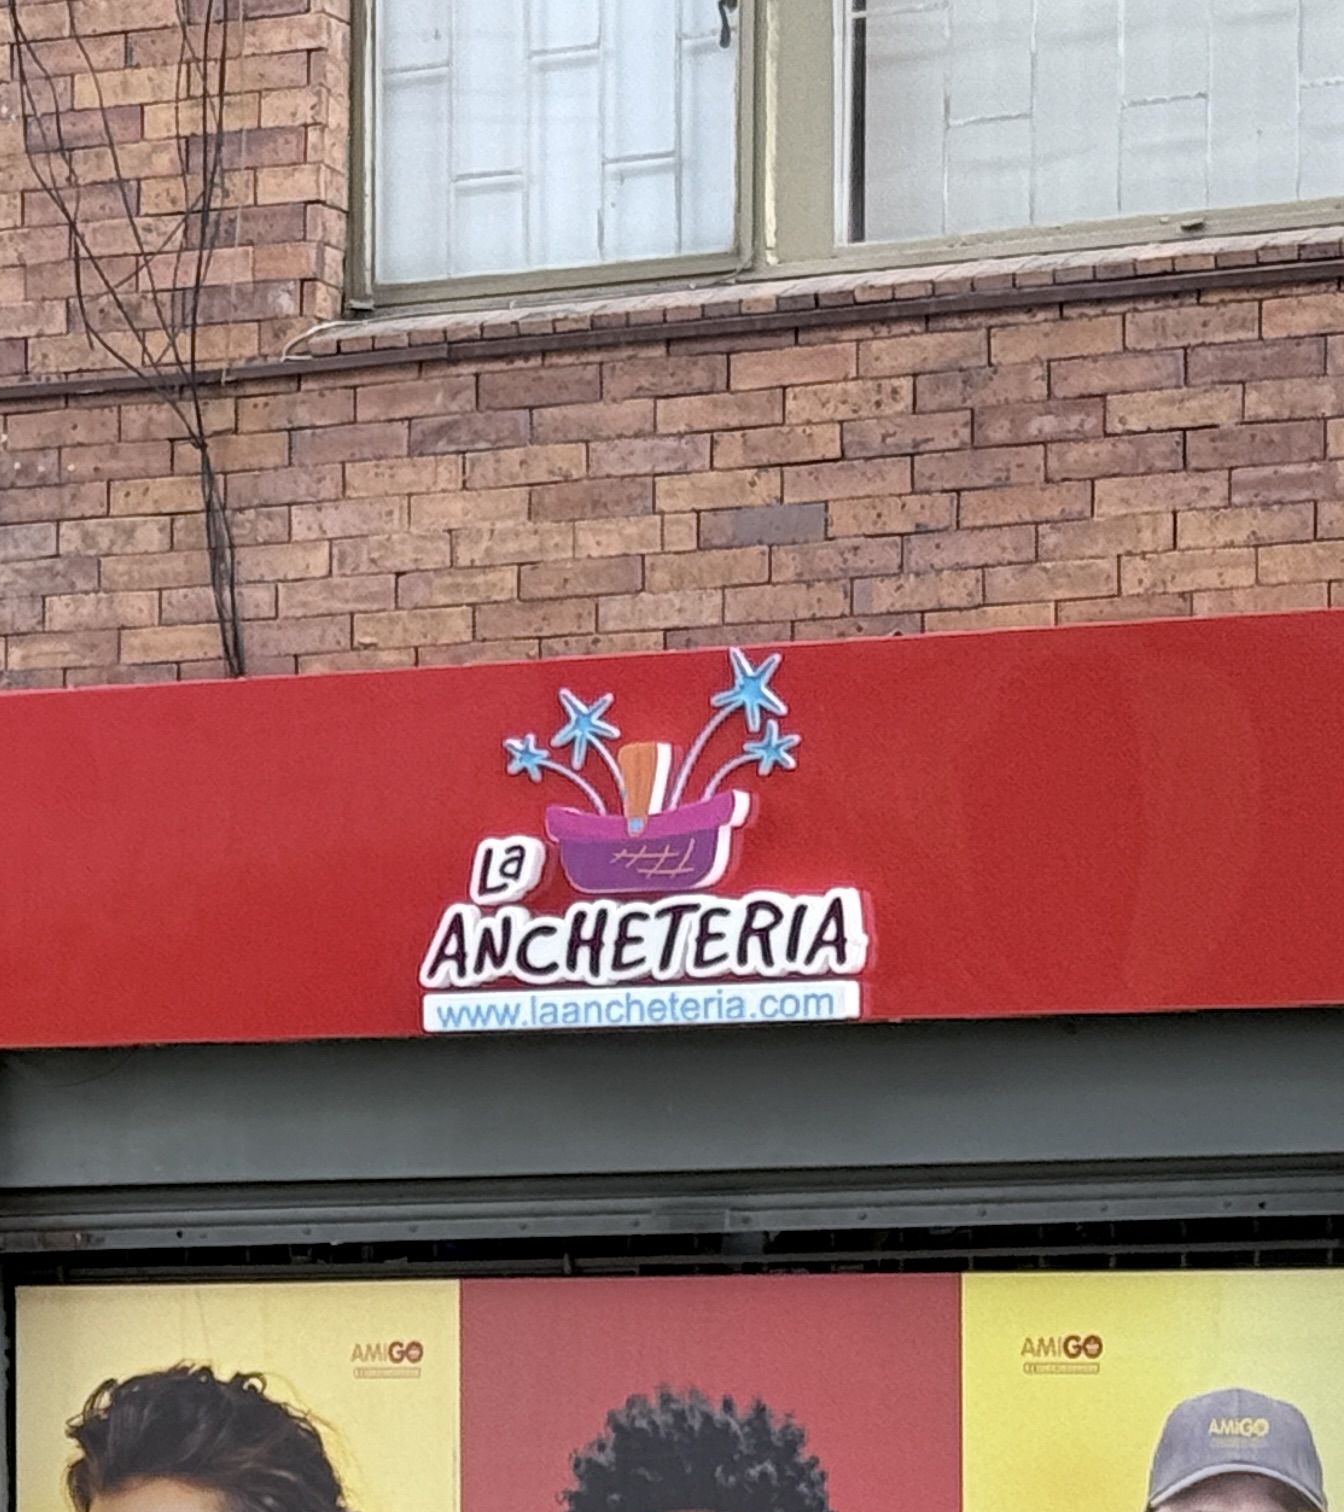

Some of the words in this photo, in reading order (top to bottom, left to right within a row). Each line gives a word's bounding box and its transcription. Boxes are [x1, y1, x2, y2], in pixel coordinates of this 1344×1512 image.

[427, 897, 849, 980] ANCHETERIA
[436, 988, 836, 1028] www.laancheteria.com
[350, 1341, 424, 1364] AMIGO
[1020, 1335, 1103, 1360] AMIGO
